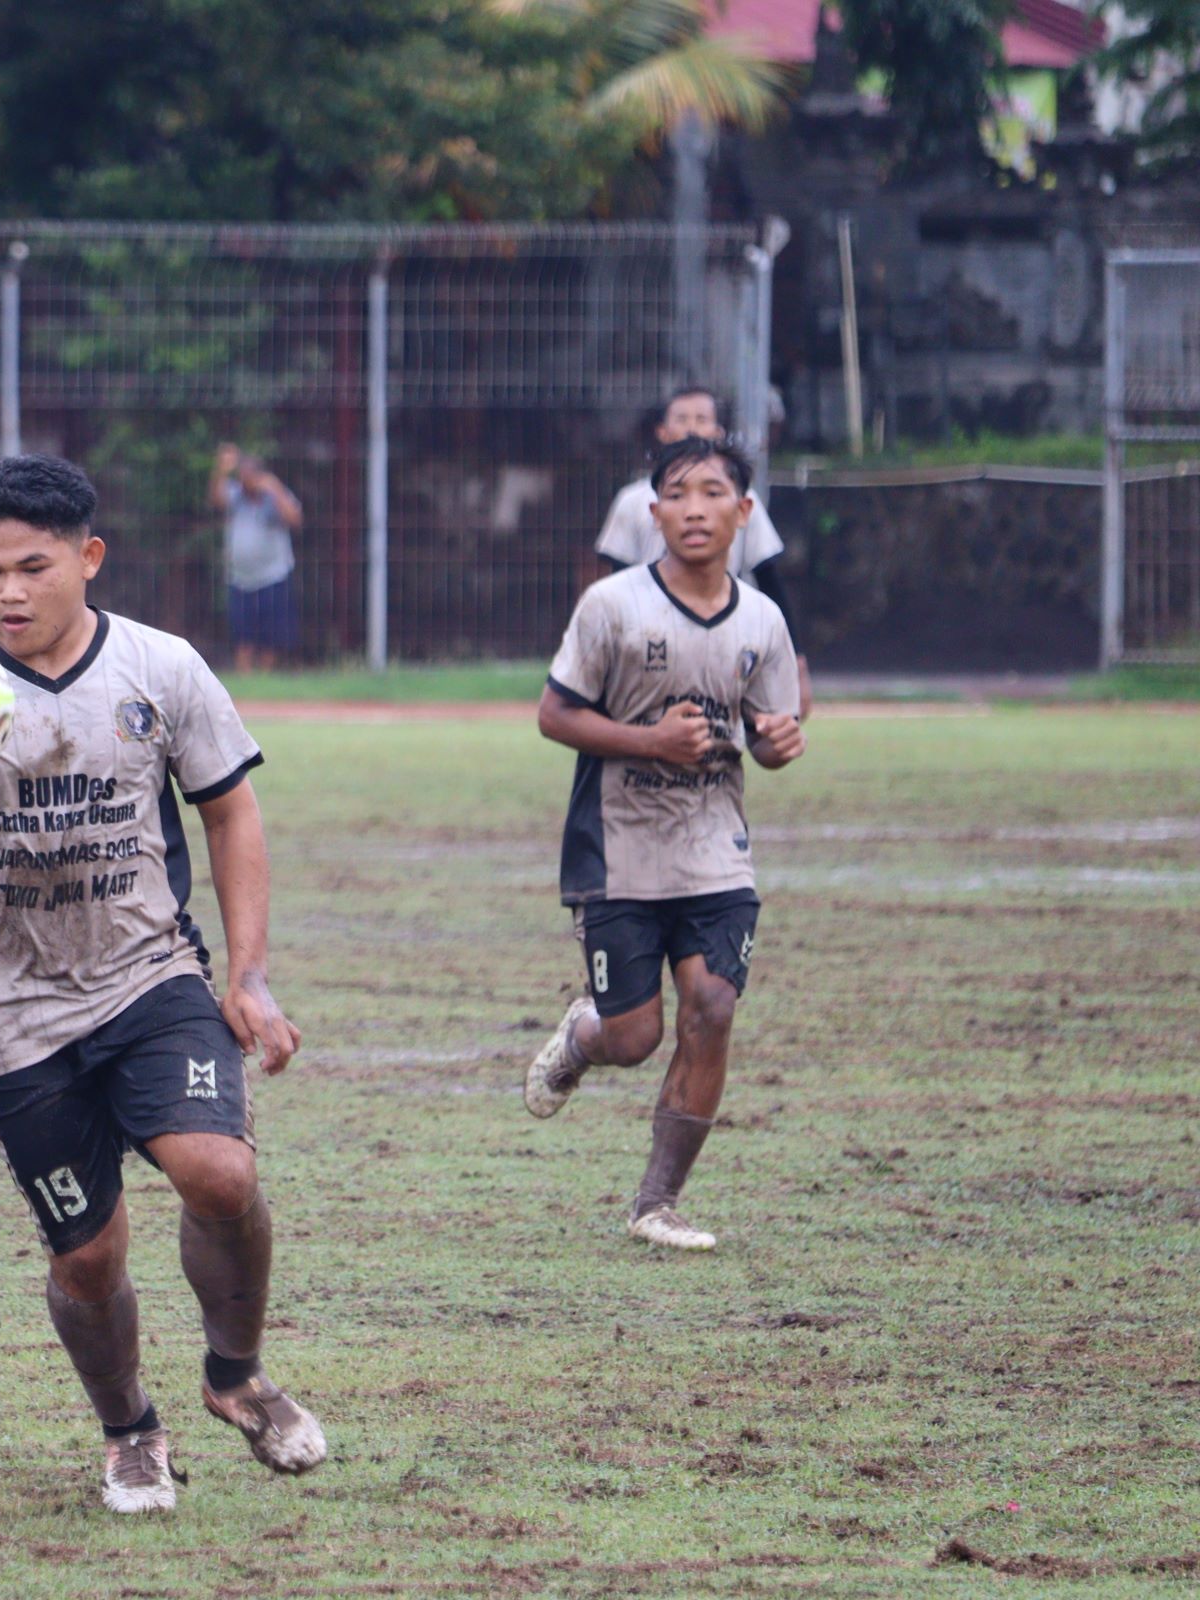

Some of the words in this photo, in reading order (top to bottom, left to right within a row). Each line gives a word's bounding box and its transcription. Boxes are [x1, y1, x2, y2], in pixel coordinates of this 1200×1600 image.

[18, 773, 118, 808] BUMDes
[88, 803, 136, 825] Utama
[60, 842, 101, 867] MAS
[91, 870, 138, 903] MART
[593, 949, 609, 993] 8
[186, 1088, 219, 1099] EMJE
[34, 1166, 88, 1223] 19
